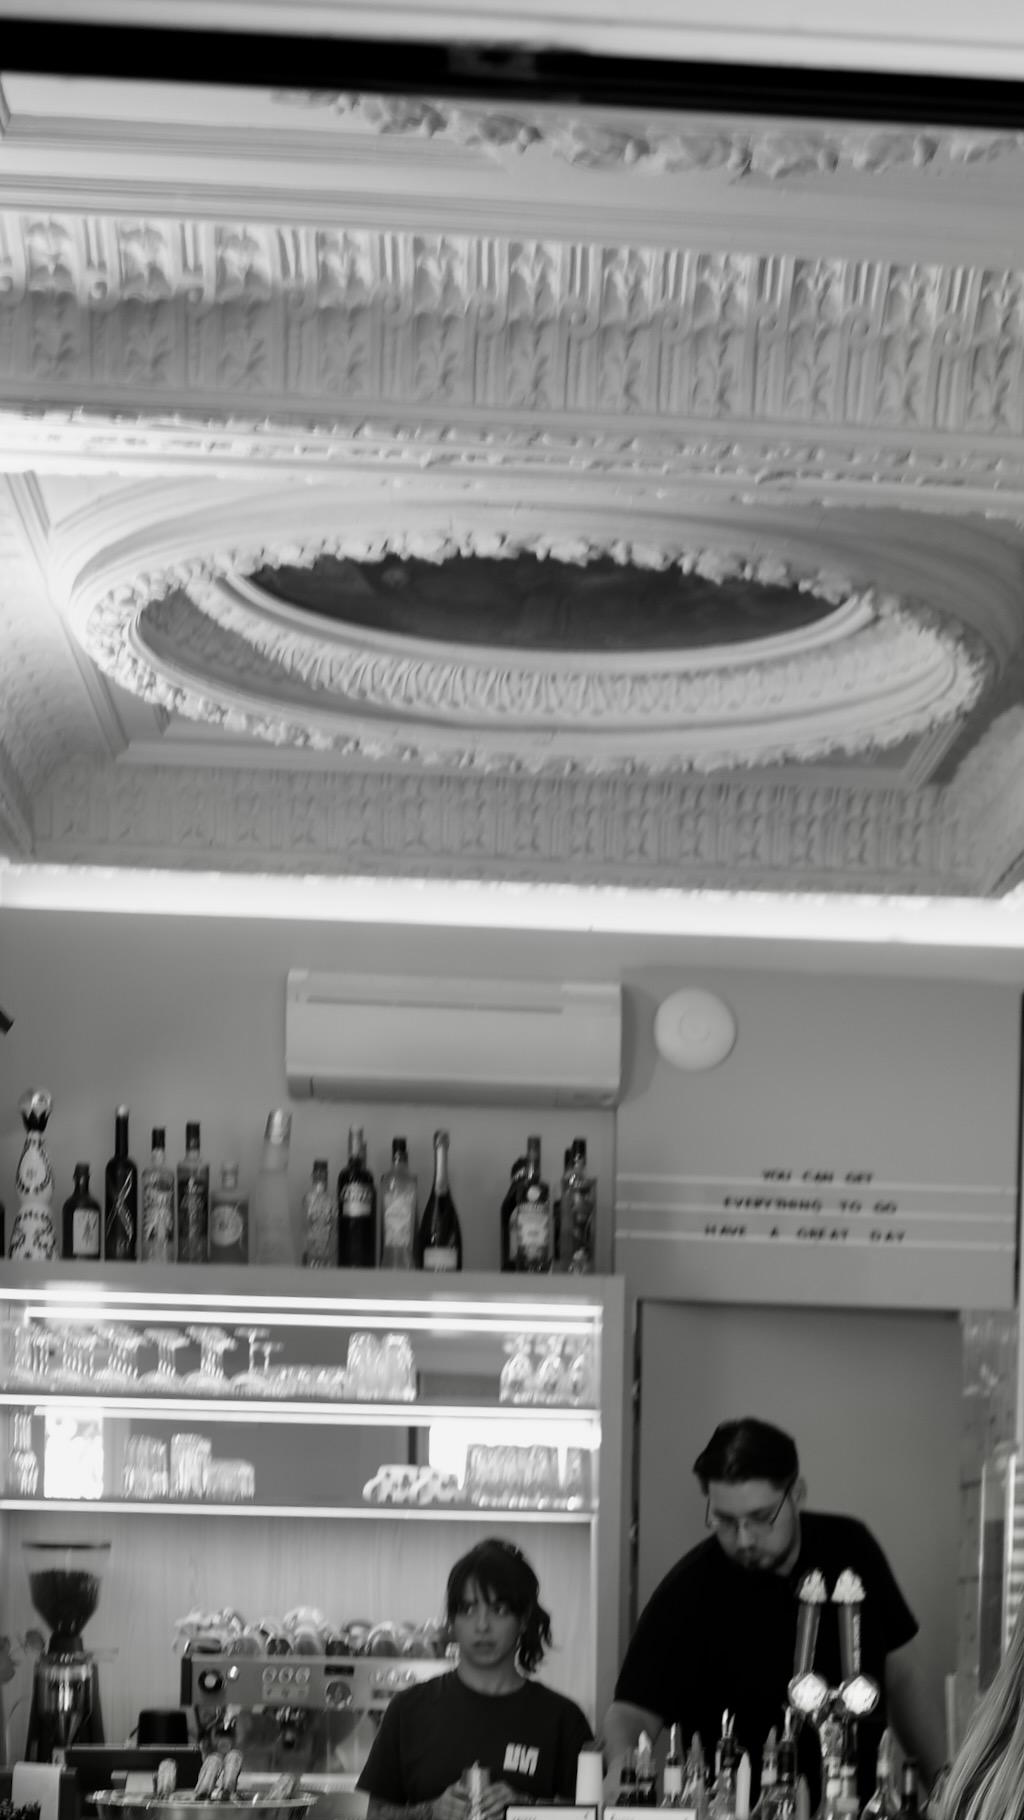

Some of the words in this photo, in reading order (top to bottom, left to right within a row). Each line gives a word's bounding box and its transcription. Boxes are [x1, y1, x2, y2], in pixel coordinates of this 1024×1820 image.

[704, 1224, 747, 1237] HAVE
[797, 1226, 850, 1241] GREAT
[870, 1229, 906, 1243] DAY
